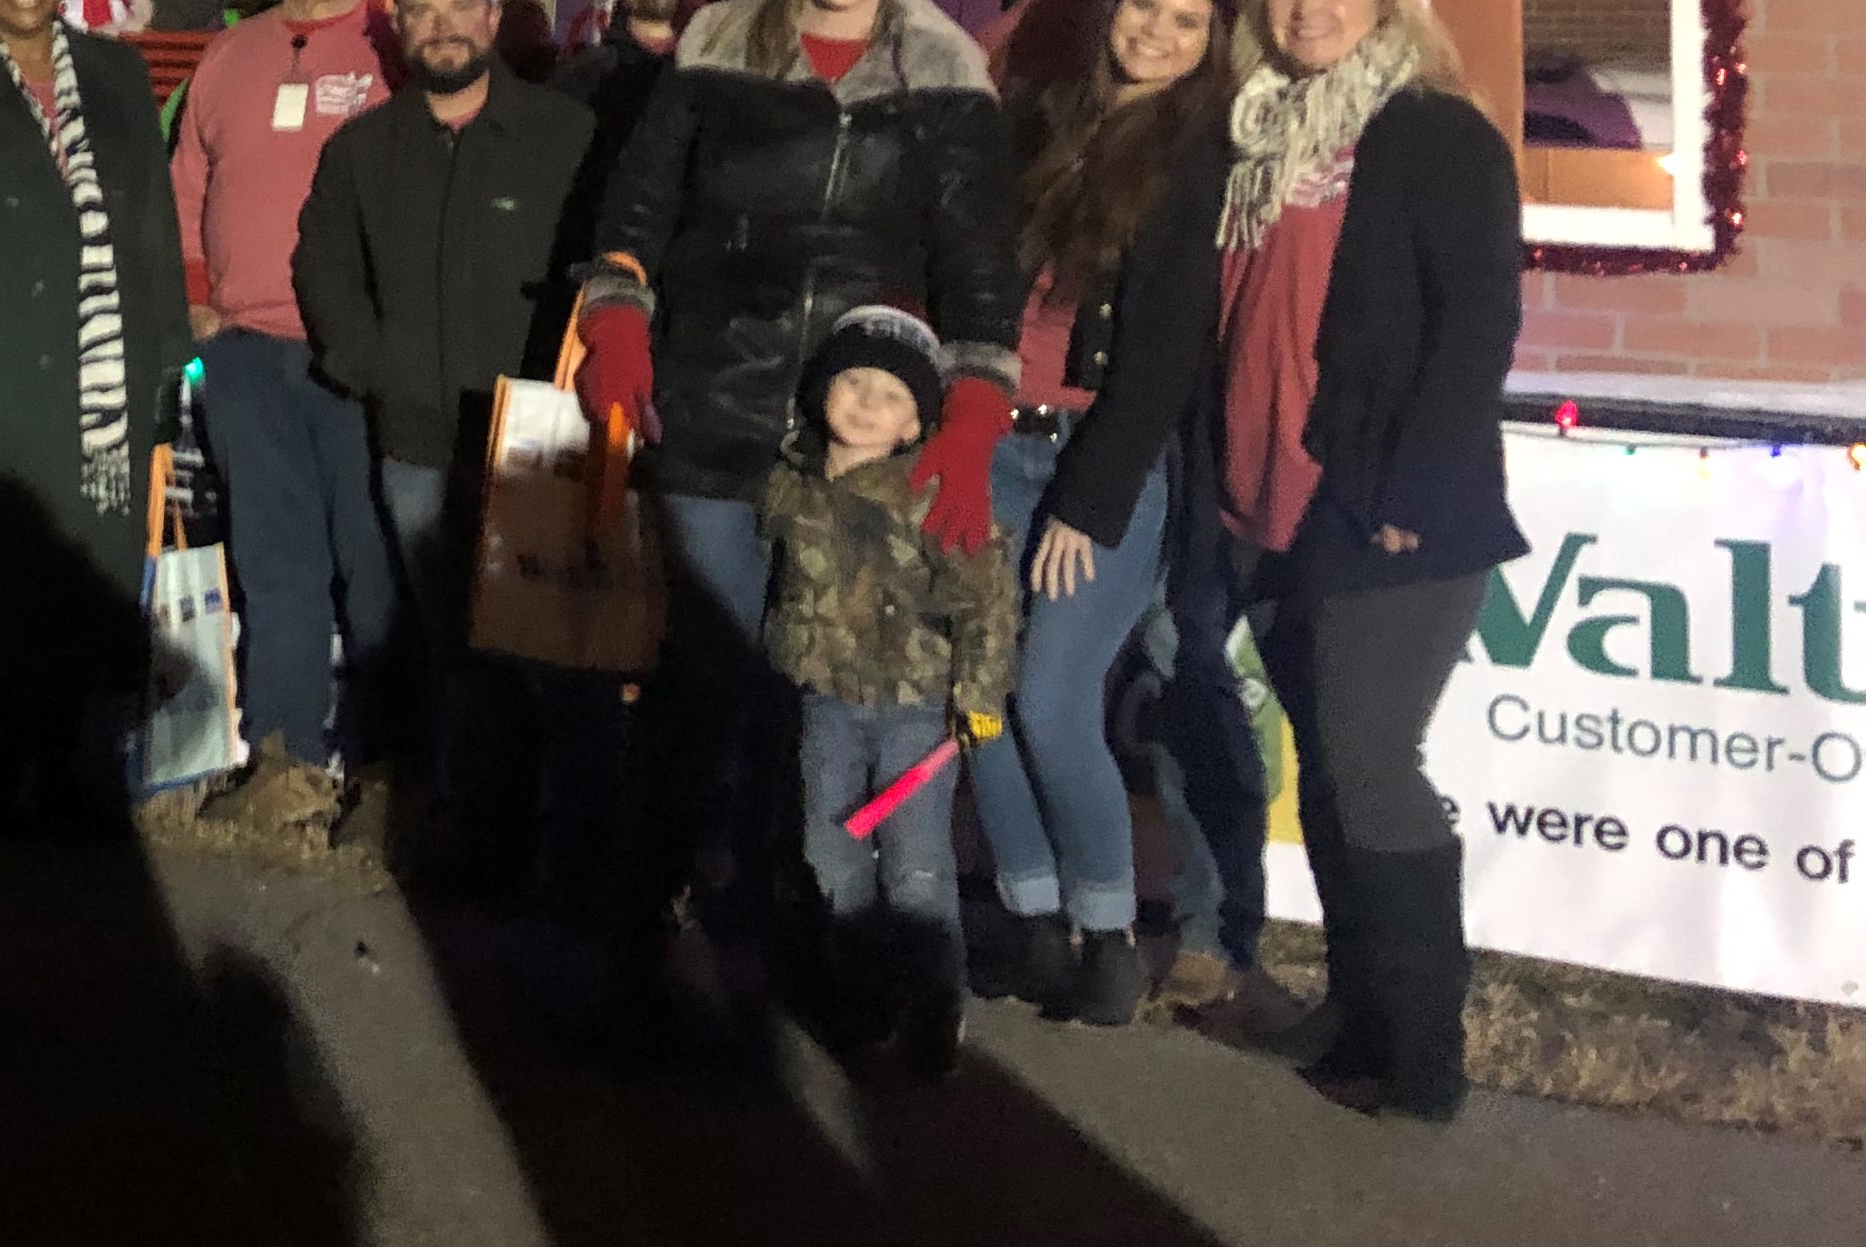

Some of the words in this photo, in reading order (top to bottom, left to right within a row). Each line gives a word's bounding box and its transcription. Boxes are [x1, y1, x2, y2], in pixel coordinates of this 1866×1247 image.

[1486, 693, 1863, 783] Customer-O
[1485, 800, 1630, 852] were
[1655, 822, 1770, 871] one
[1795, 838, 1856, 884] of
